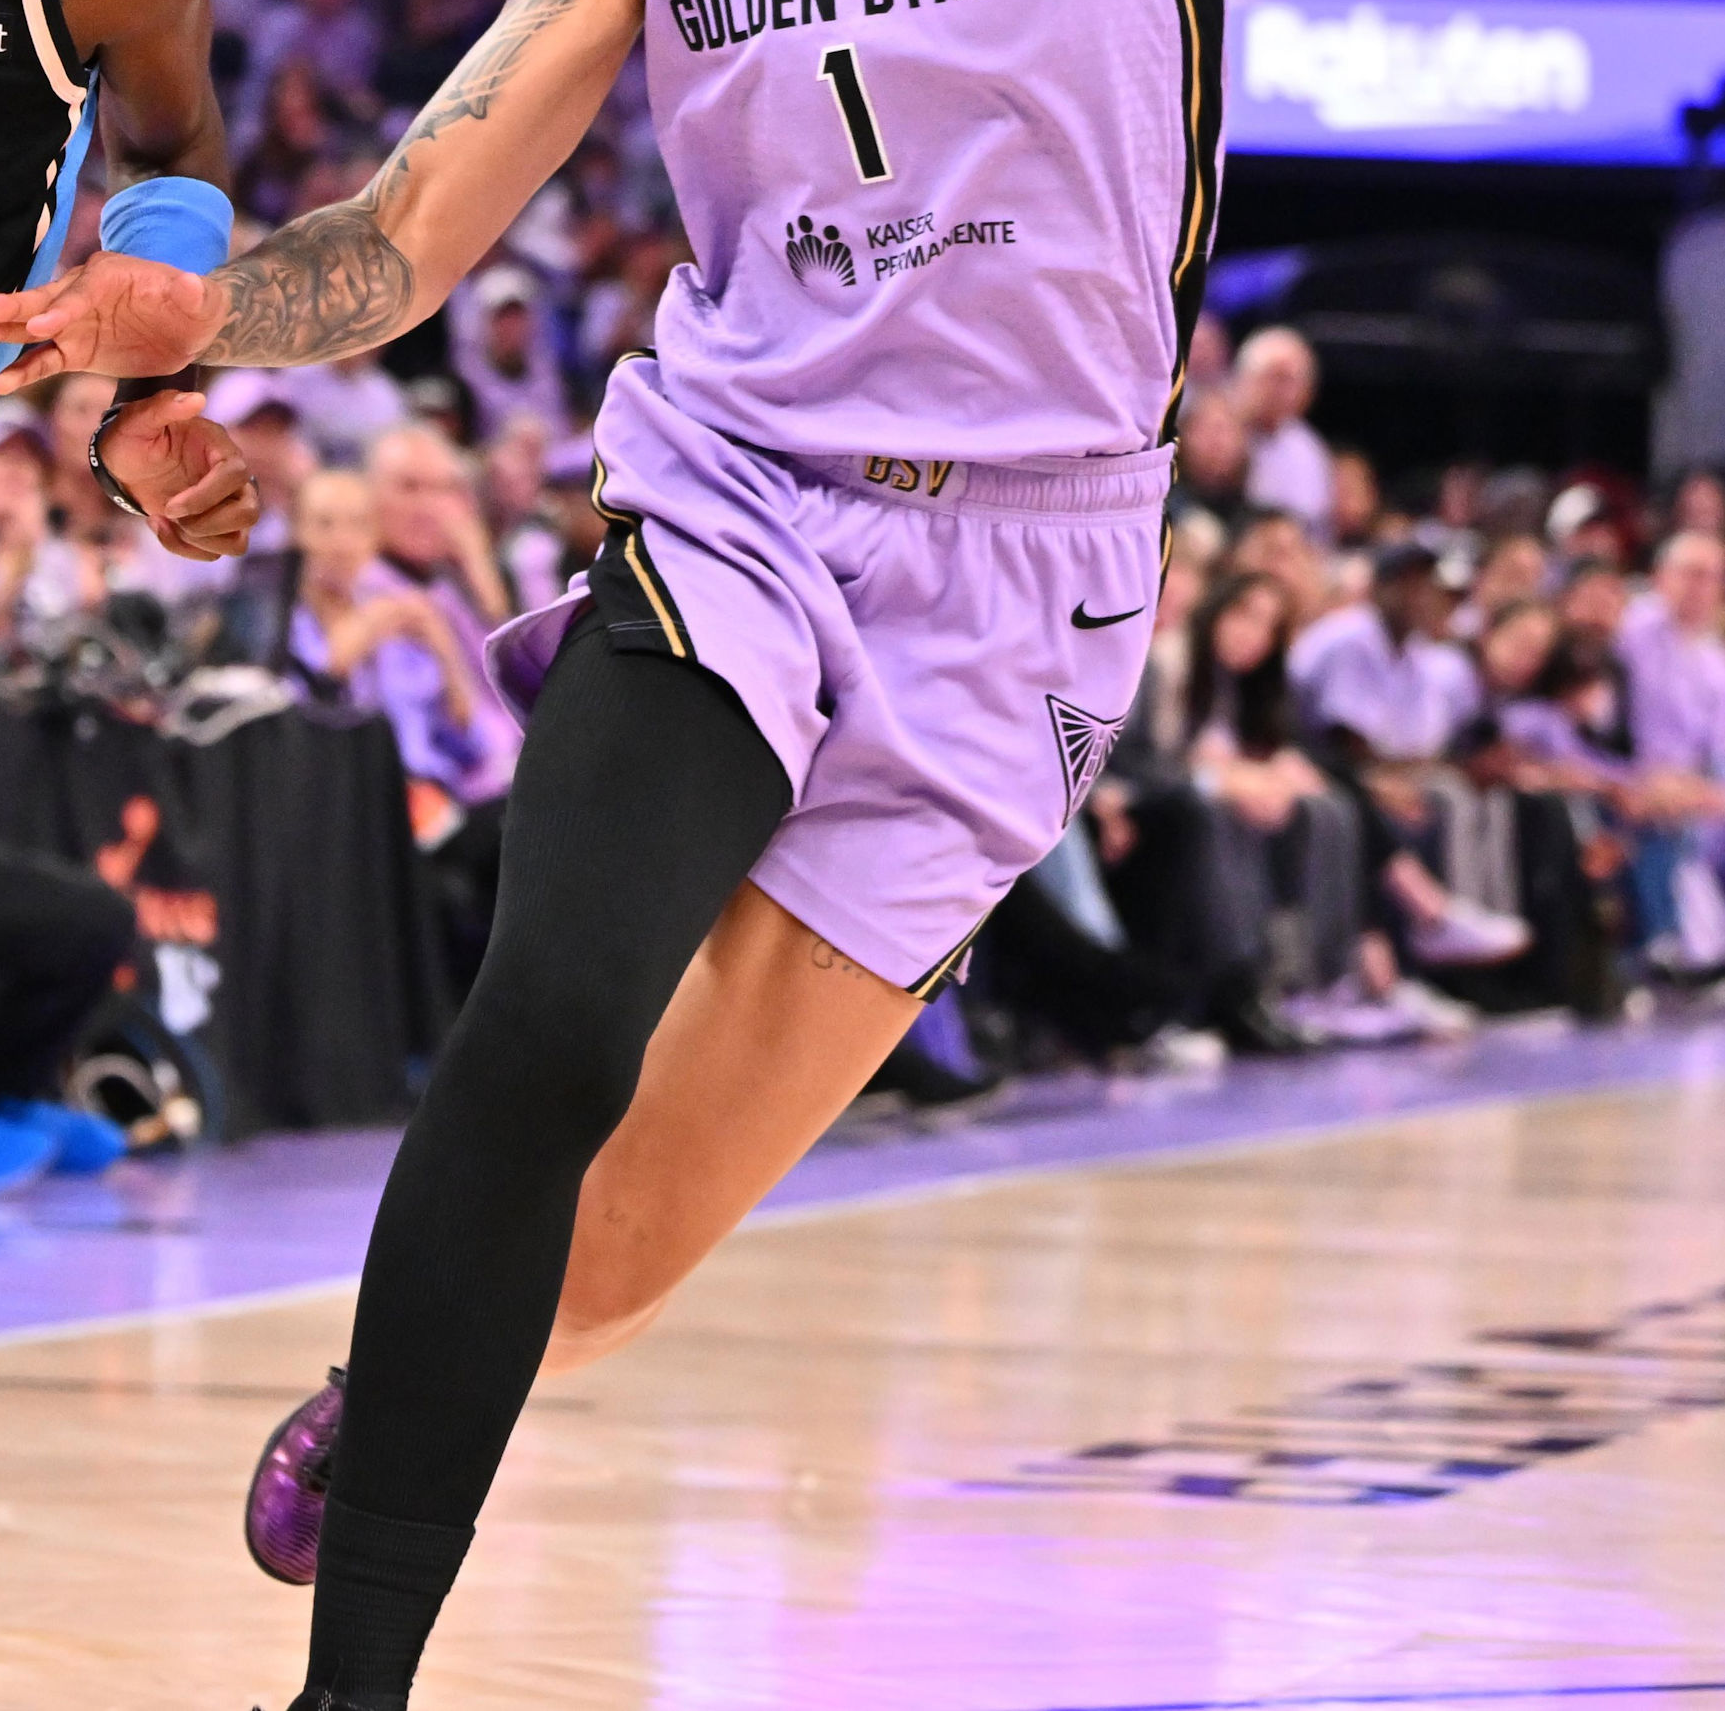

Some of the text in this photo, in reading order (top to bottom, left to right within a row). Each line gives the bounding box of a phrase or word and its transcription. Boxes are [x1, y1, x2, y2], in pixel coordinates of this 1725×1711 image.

[816, 42, 894, 185] 1
[1246, 4, 1590, 116] Rakuten
[866, 212, 936, 250] KAISER
